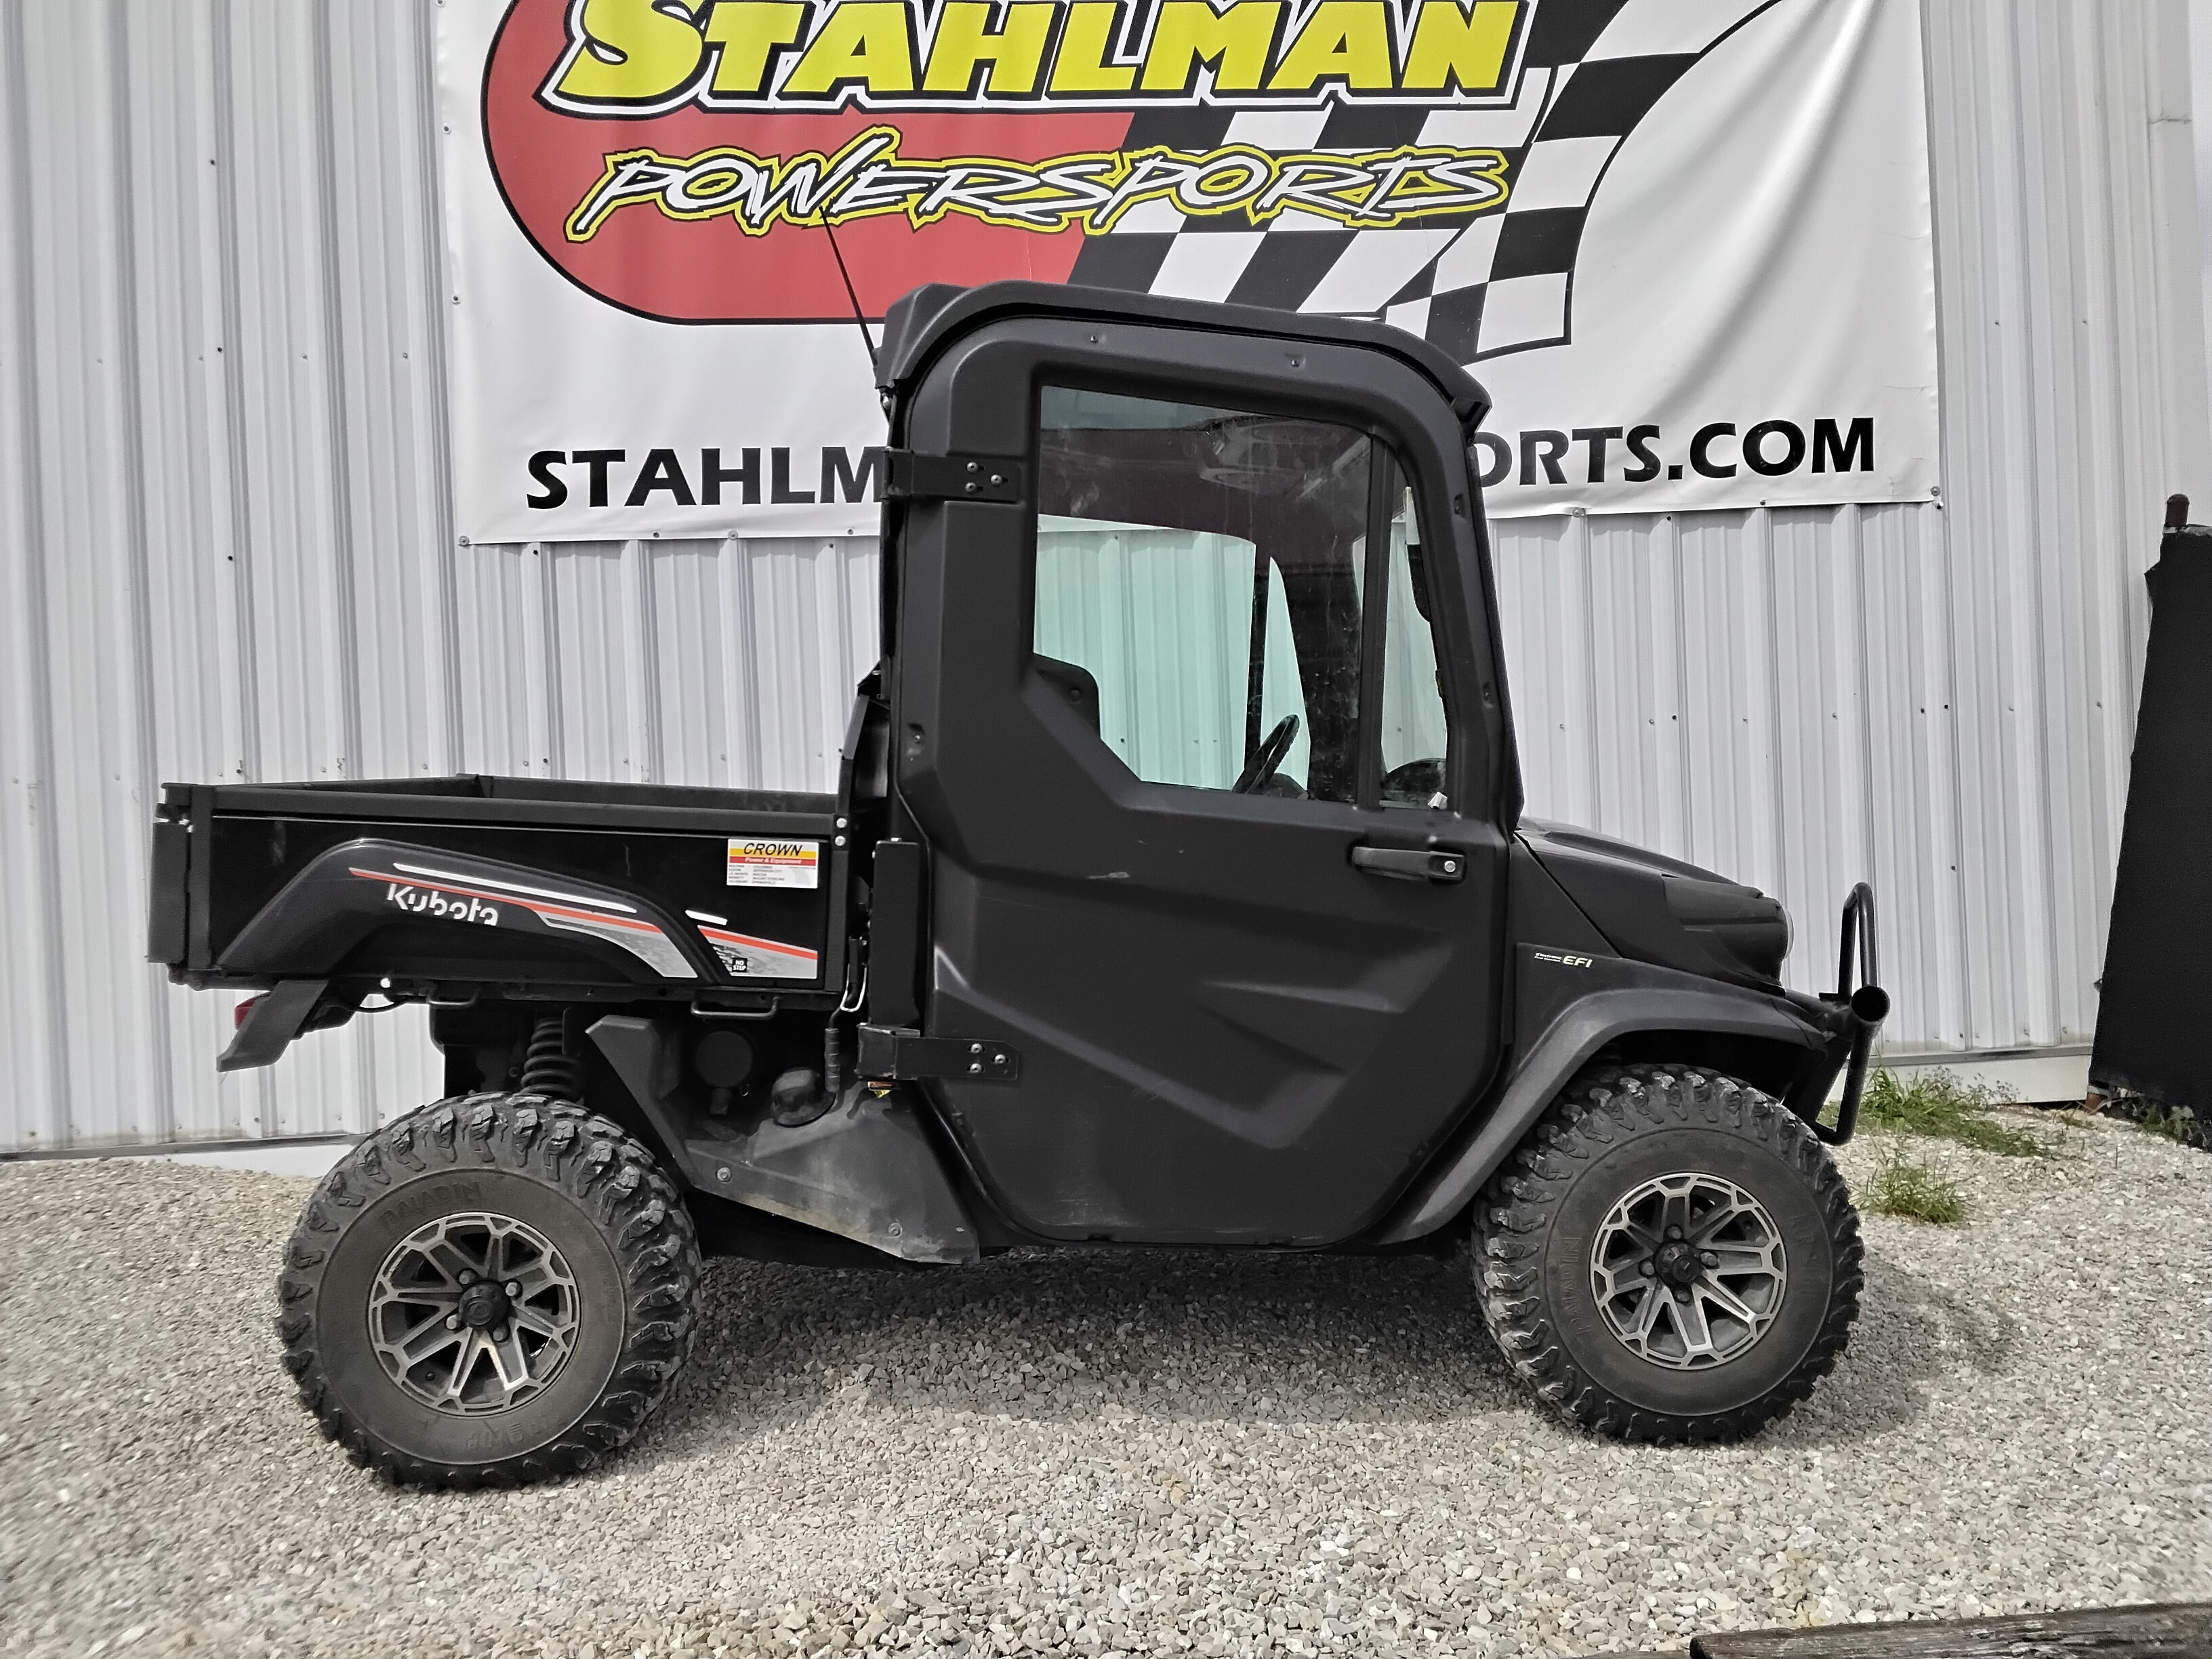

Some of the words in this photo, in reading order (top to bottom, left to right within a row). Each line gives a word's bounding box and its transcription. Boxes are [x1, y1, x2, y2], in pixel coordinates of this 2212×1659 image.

[537, 0, 1533, 108] STAHLMAN
[567, 125, 1509, 241] POWERSPORTS
[743, 842, 803, 856] CROWN
[386, 883, 499, 926] Kubota
[1563, 956, 1593, 967] EFI
